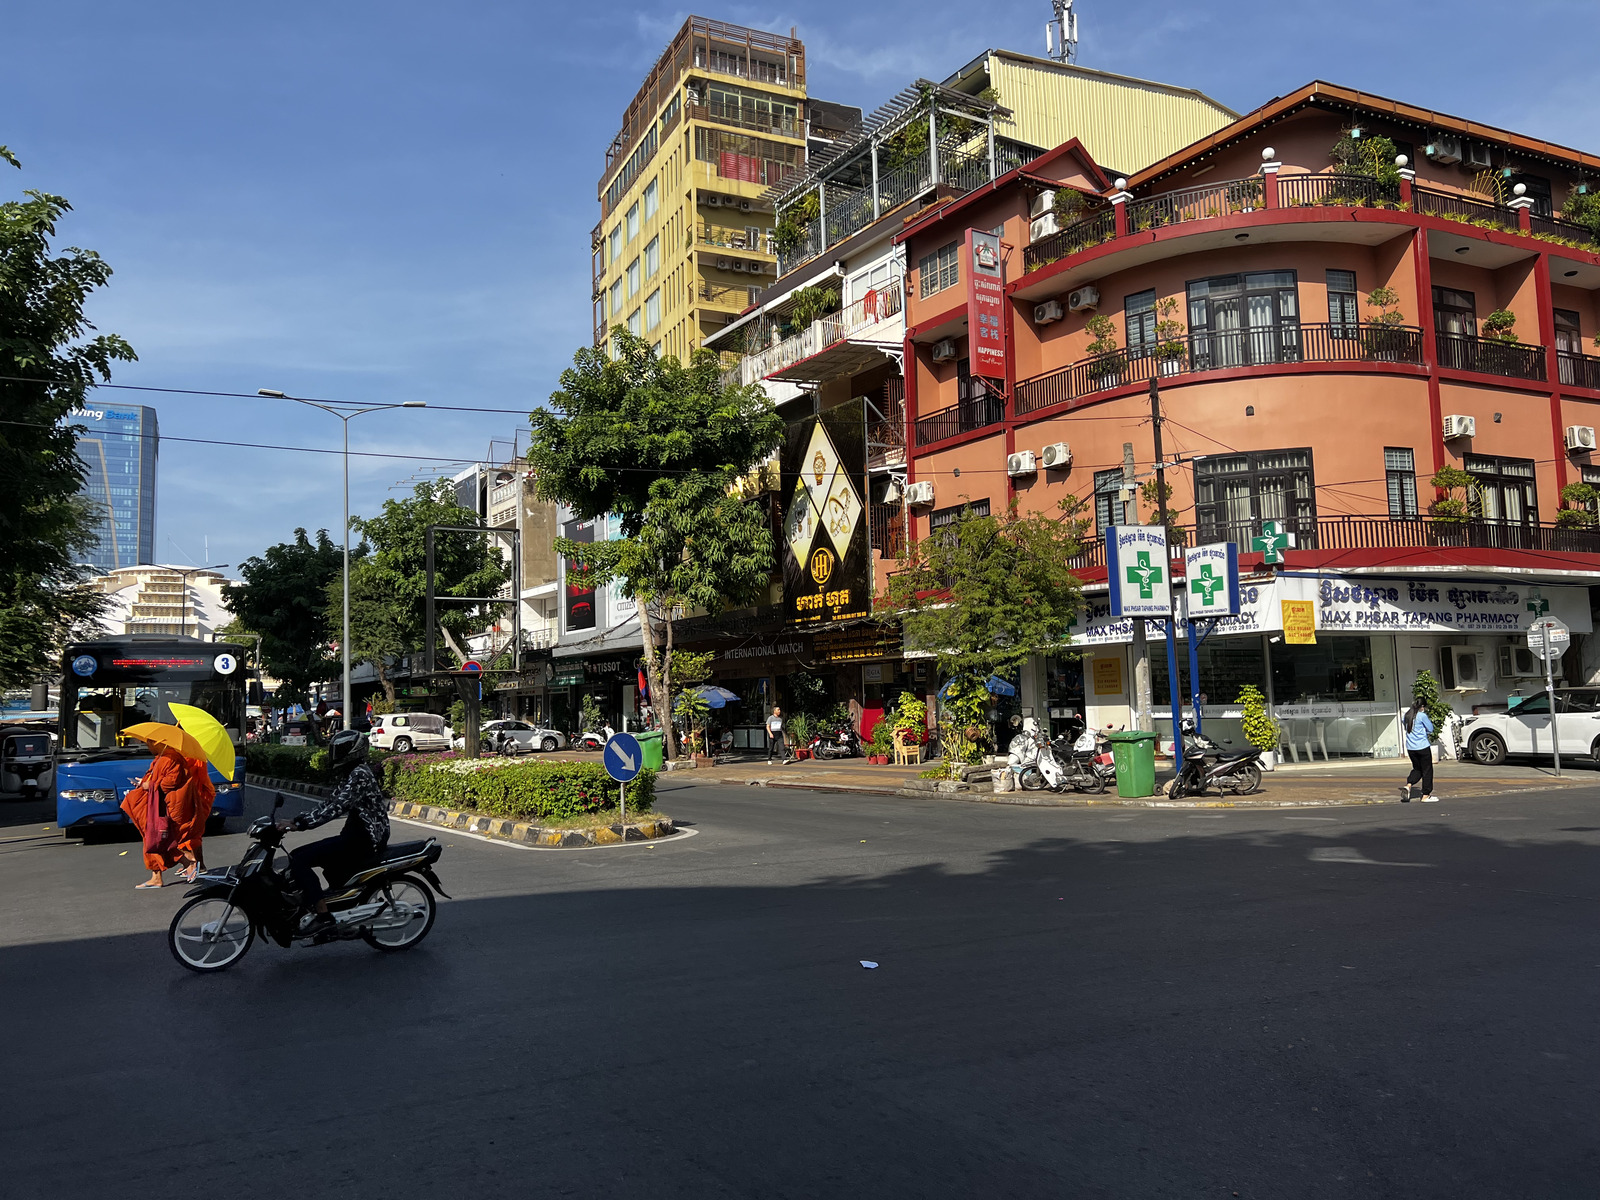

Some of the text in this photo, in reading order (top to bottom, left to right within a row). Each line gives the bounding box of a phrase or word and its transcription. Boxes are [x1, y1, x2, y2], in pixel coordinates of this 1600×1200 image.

[978, 346, 1004, 358] HAPPINESS
[72, 406, 138, 421] Wing Bank
[1321, 610, 1351, 623] MAX
[1356, 612, 1399, 624] PHSAR
[1402, 612, 1452, 624] TAPANG
[1456, 612, 1520, 624] PHARMACY
[1086, 625, 1107, 637] MAX
[1109, 622, 1134, 636] PHSA
[724, 645, 776, 660] INTERNATIONAL
[778, 642, 804, 655] WATCH
[221, 657, 230, 669] 3
[597, 661, 621, 673] TISSOT
